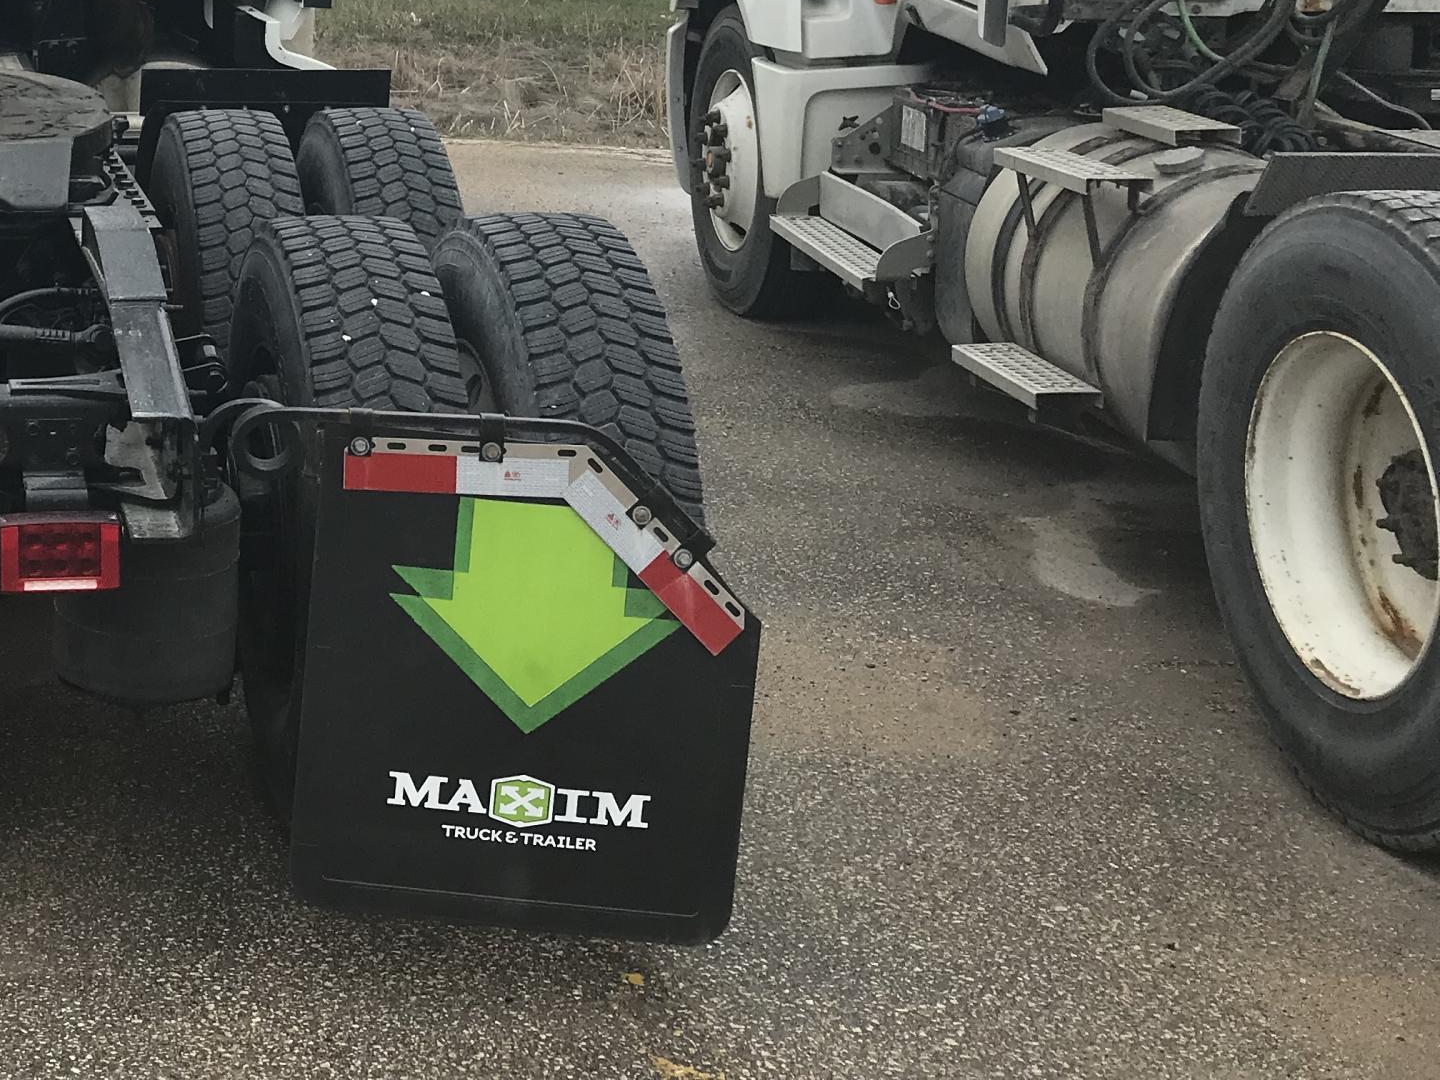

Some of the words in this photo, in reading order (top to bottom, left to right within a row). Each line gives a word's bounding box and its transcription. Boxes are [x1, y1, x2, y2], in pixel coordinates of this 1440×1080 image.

[386, 771, 652, 829] MAXIM
[442, 824, 503, 843] TRUCK
[519, 832, 597, 852] TRAILER
